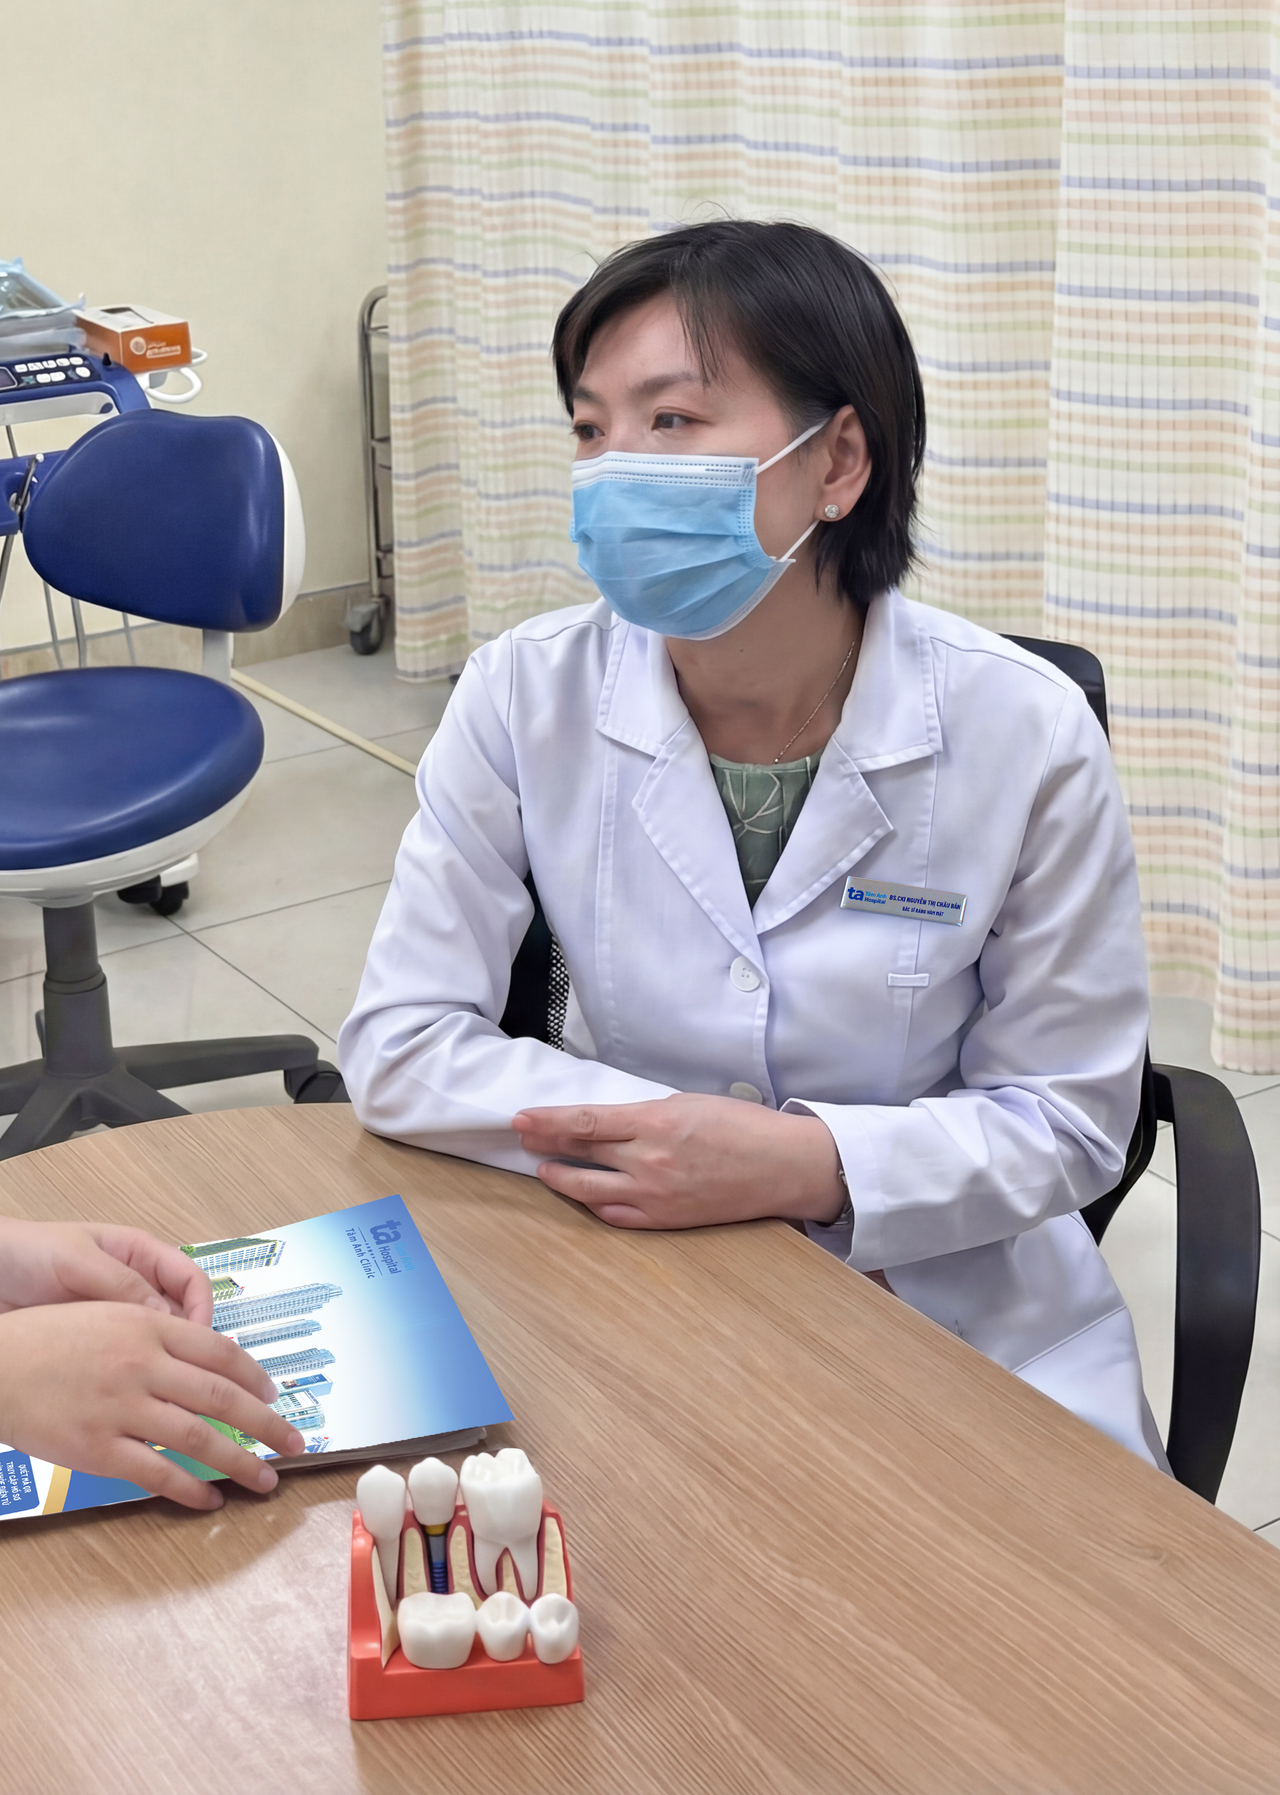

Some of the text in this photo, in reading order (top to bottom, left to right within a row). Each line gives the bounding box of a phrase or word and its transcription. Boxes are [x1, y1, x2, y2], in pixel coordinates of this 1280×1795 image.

[848, 887, 864, 901] ta
[370, 1219, 402, 1246] ta
[352, 1243, 367, 1258] Anh
[360, 1258, 376, 1279] Clinic
[378, 1245, 402, 1275] Hospital
[400, 1256, 416, 1271] Anh
